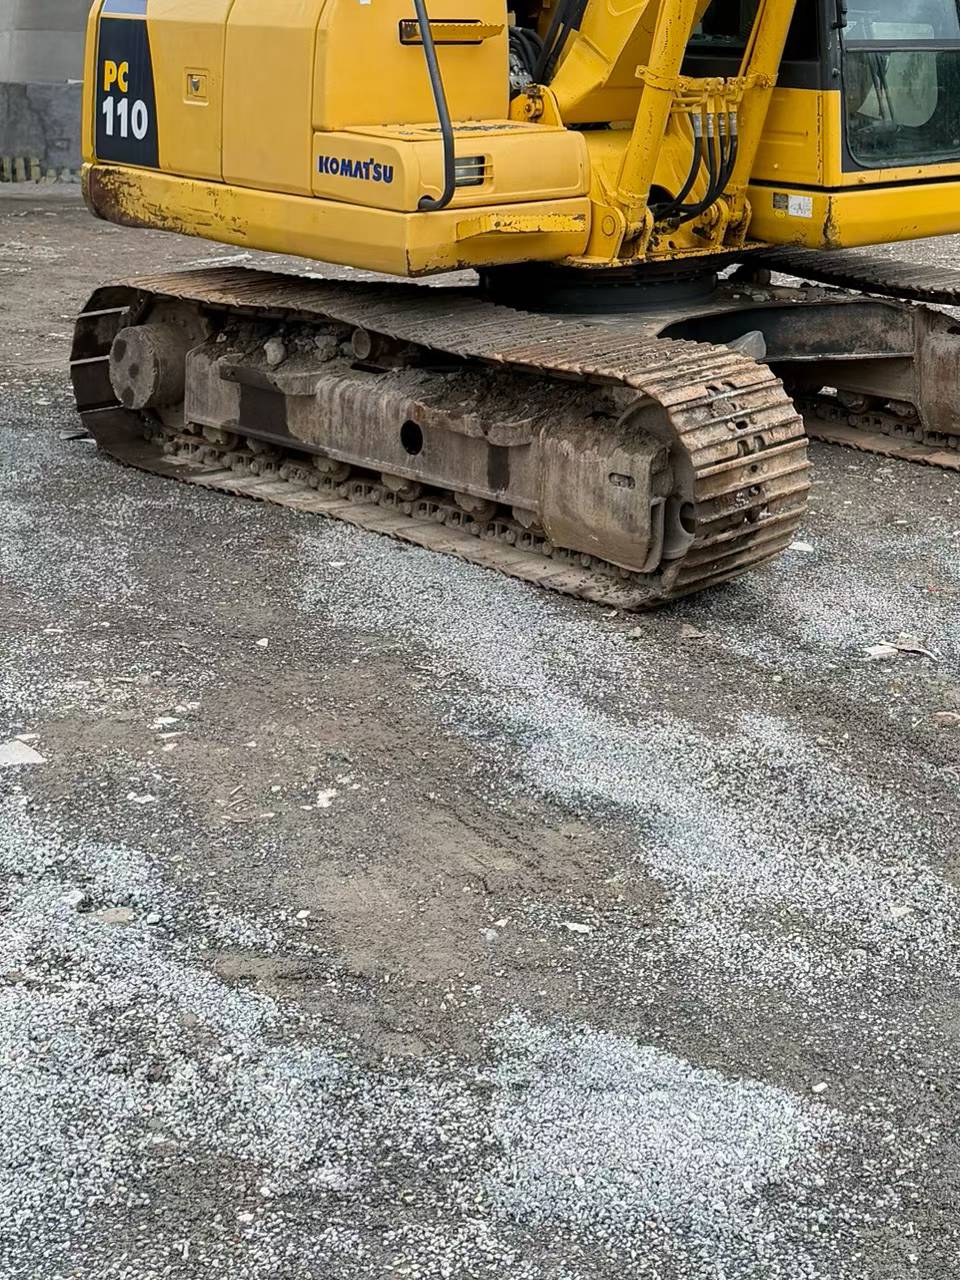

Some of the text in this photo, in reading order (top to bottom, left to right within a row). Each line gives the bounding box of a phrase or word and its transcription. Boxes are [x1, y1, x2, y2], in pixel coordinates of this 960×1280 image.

[103, 60, 129, 93] PC
[102, 96, 149, 140] 110
[318, 155, 394, 184] KOMATSU
